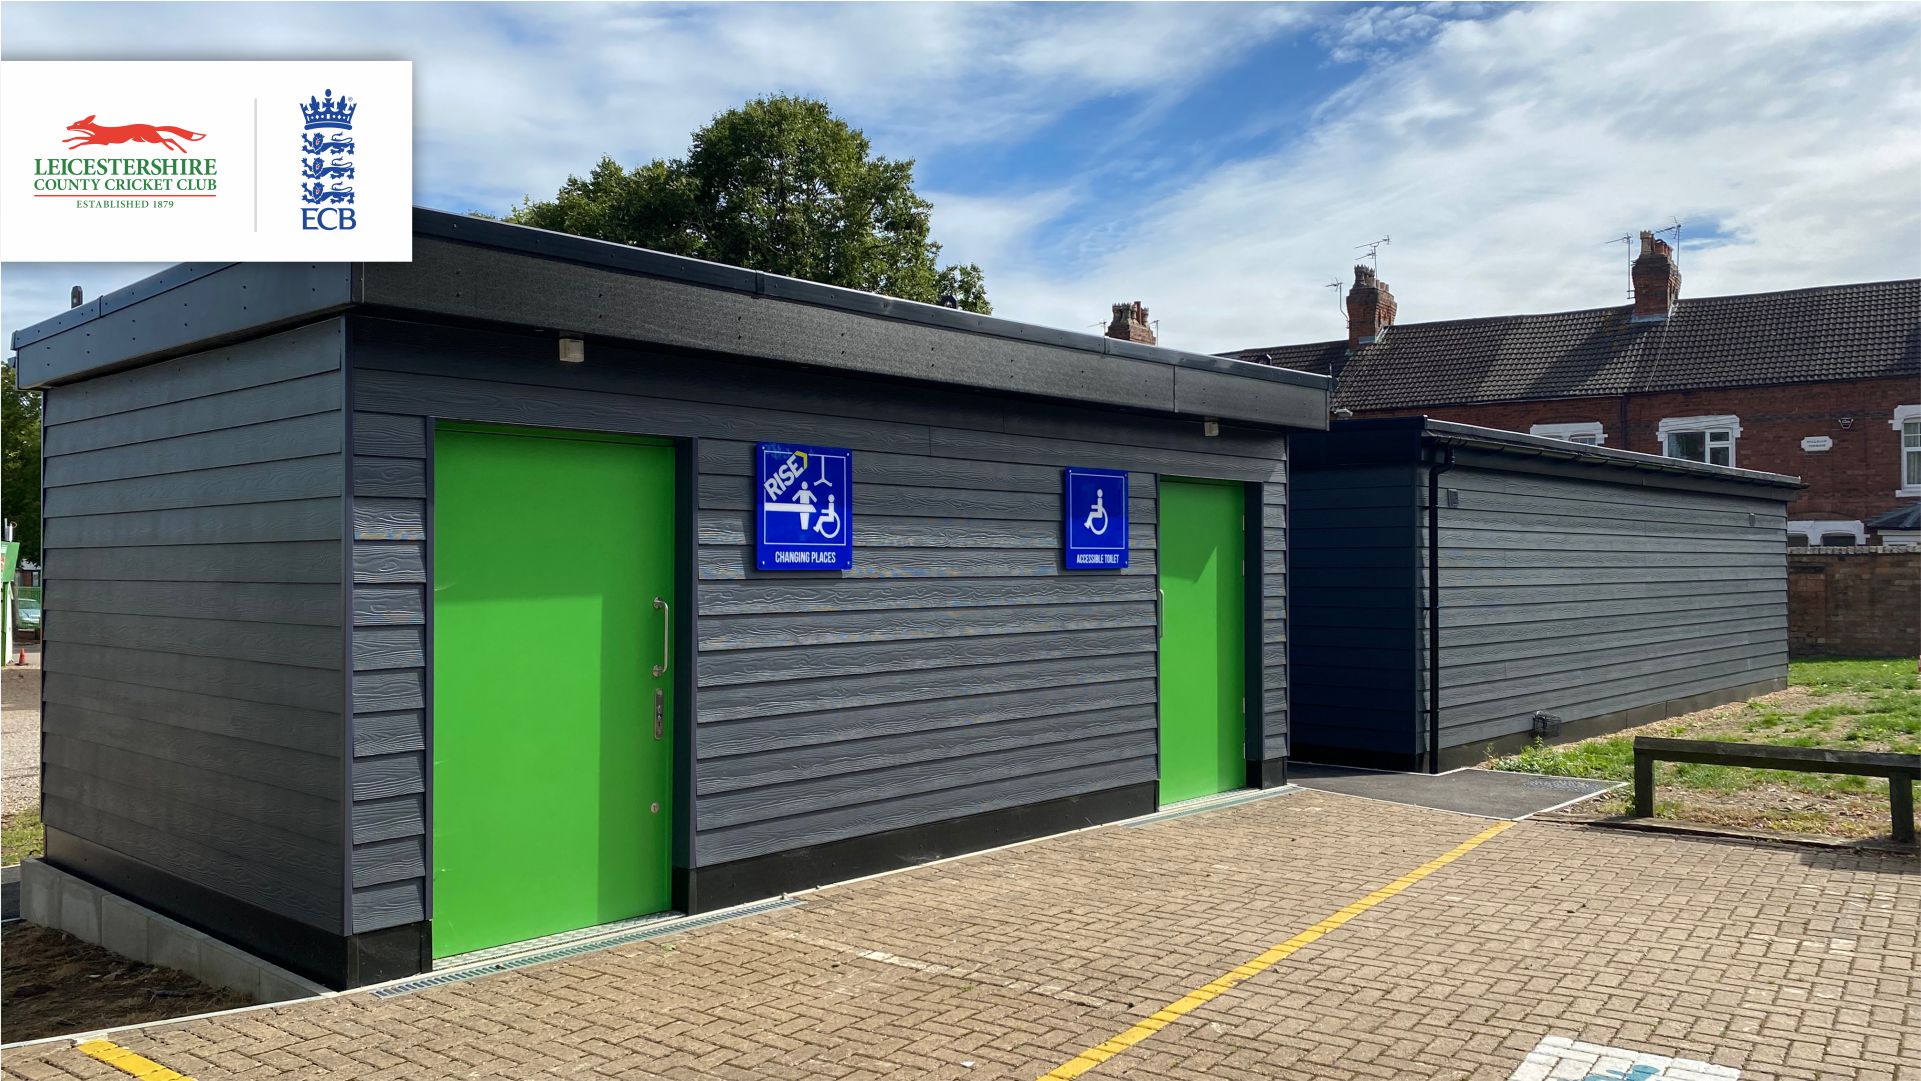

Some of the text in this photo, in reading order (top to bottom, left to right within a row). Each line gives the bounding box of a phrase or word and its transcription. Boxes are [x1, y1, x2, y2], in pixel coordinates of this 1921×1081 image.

[764, 455, 804, 501] RISE
[775, 551, 836, 563] CHANGING PLACES
[1076, 554, 1120, 564] ACCESSIBLE TOILET
